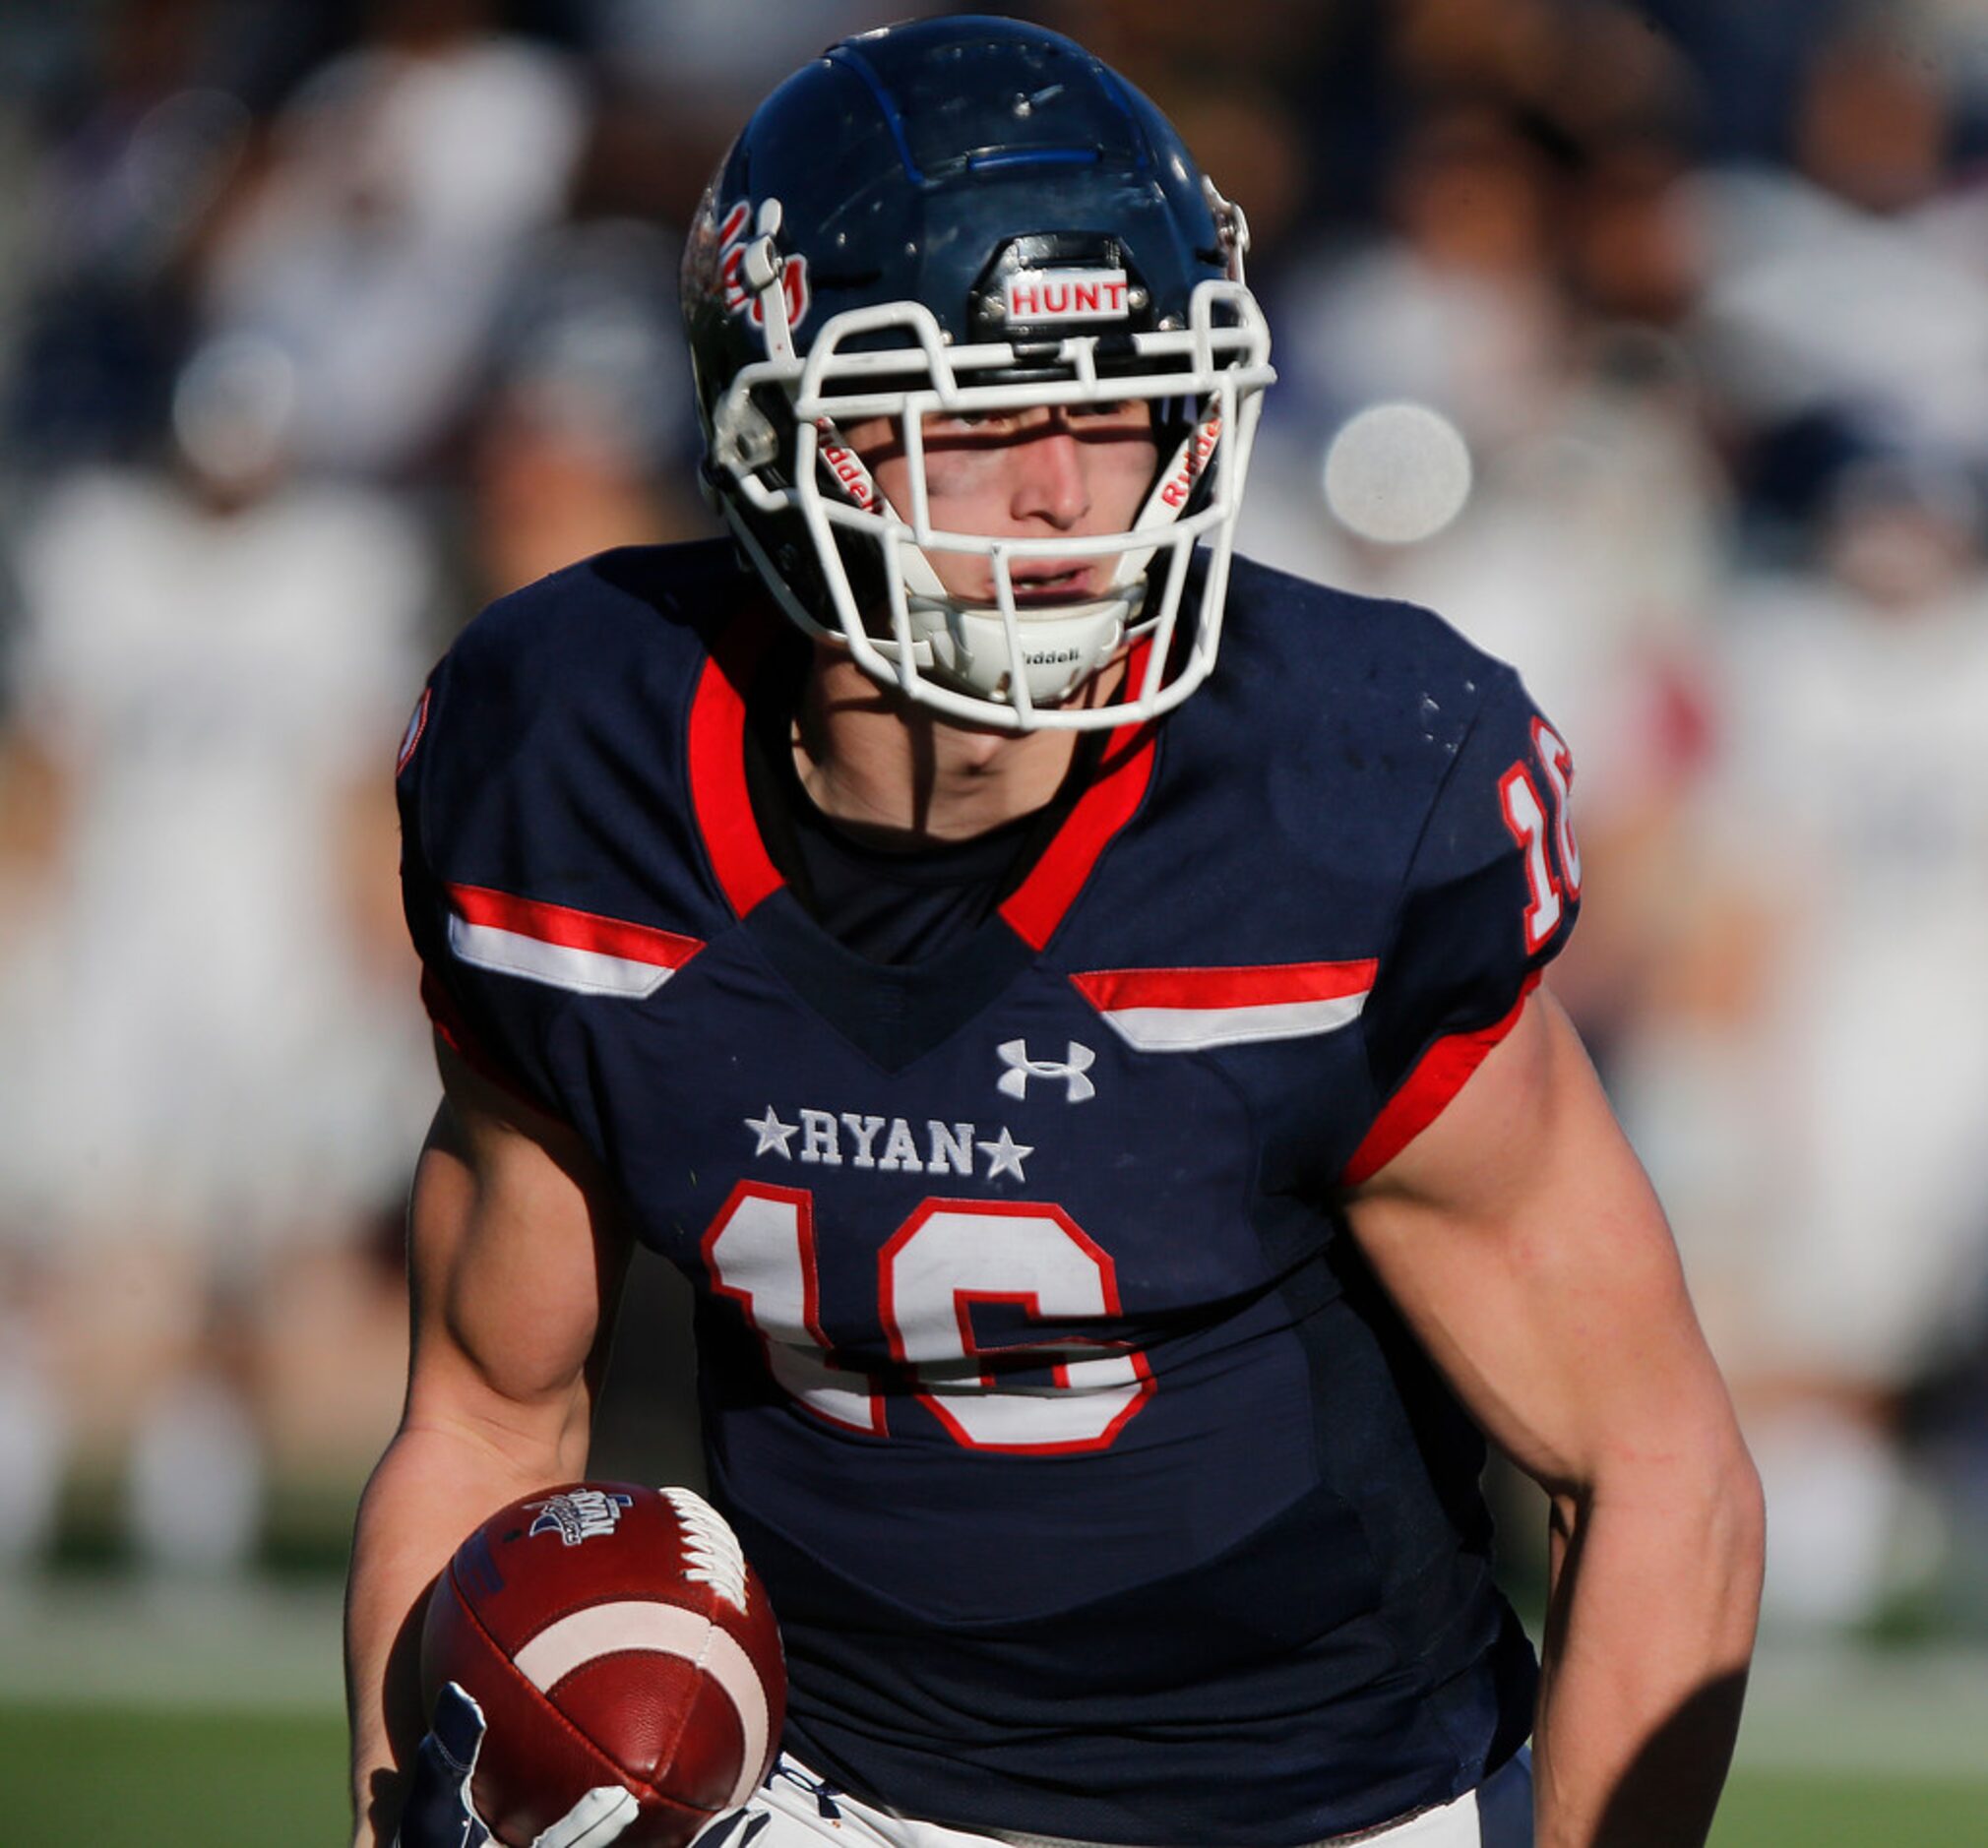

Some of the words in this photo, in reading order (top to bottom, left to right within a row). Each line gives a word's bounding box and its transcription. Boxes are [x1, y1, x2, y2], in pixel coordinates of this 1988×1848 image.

[1012, 282, 1128, 315] HUNT
[1023, 647, 1080, 665] iddell
[800, 1108, 975, 1176] RYAN
[700, 1179, 1158, 1455] 16
